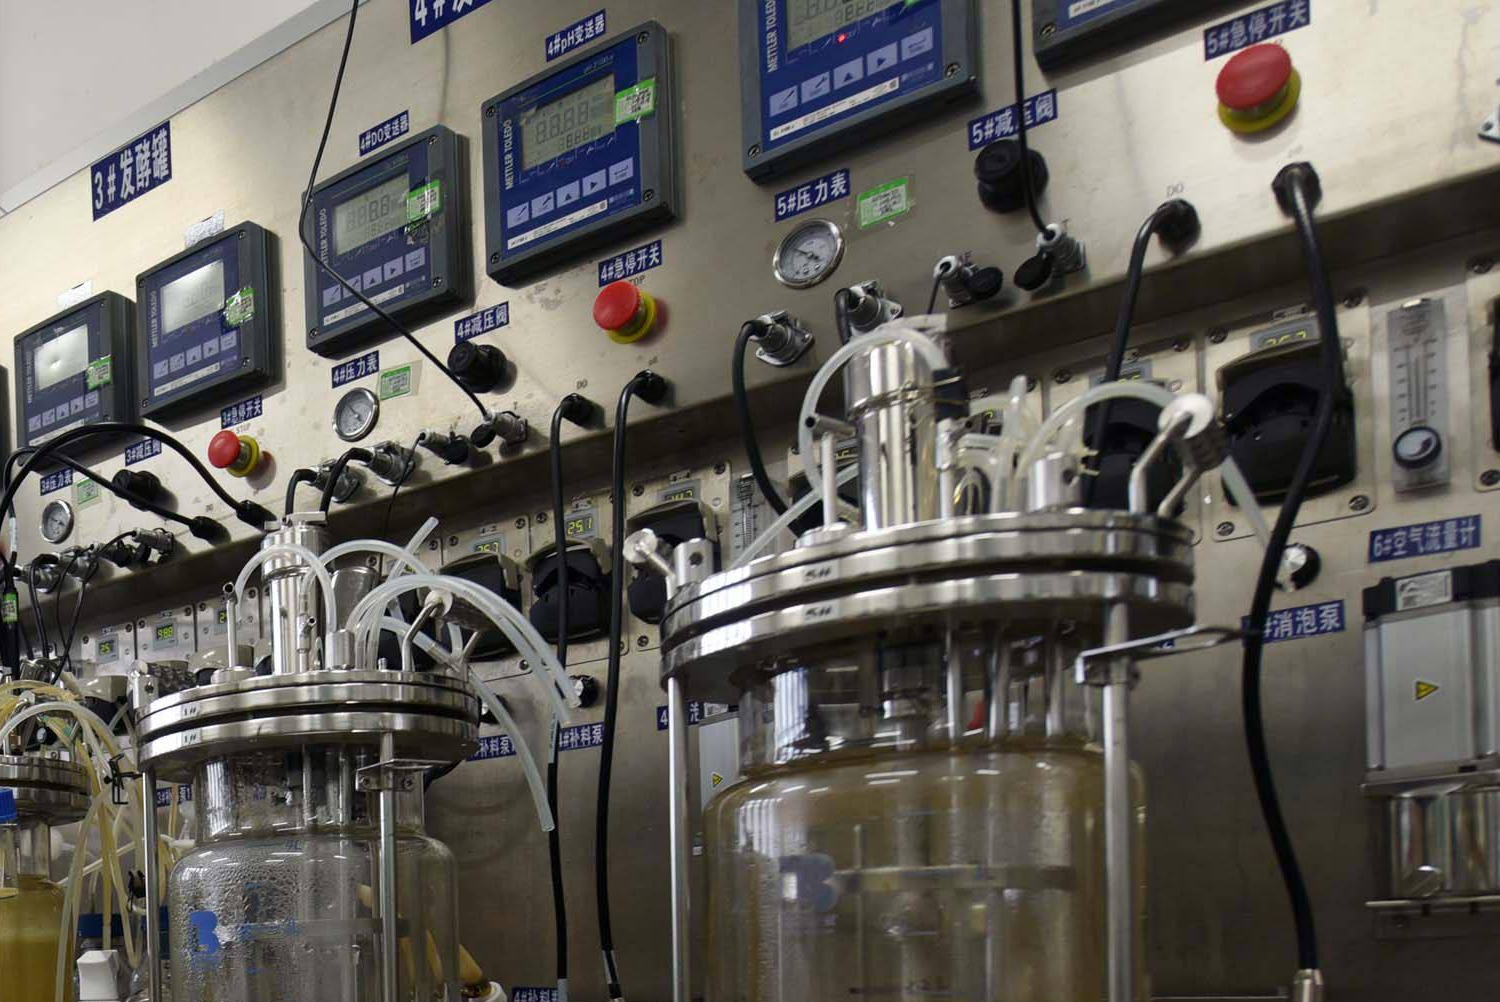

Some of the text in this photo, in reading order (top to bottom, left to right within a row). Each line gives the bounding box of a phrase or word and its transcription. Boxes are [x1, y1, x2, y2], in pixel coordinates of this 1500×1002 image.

[765, 0, 777, 31] TOLED
[1206, 0, 1308, 56] 5#急停开关
[547, 13, 605, 57] 4#pH变送器
[360, 115, 408, 152] 4#DO变送器
[94, 128, 170, 210] 3#发酵罐
[777, 171, 849, 217] 5#压力表
[600, 243, 661, 284] 4#急停开关
[457, 305, 509, 339] 4#减压阀
[333, 353, 379, 384] 4#压力表
[222, 397, 263, 428] 3#急停开关
[41, 469, 73, 495] 3#压力表
[1264, 603, 1342, 639] #消泡泵
